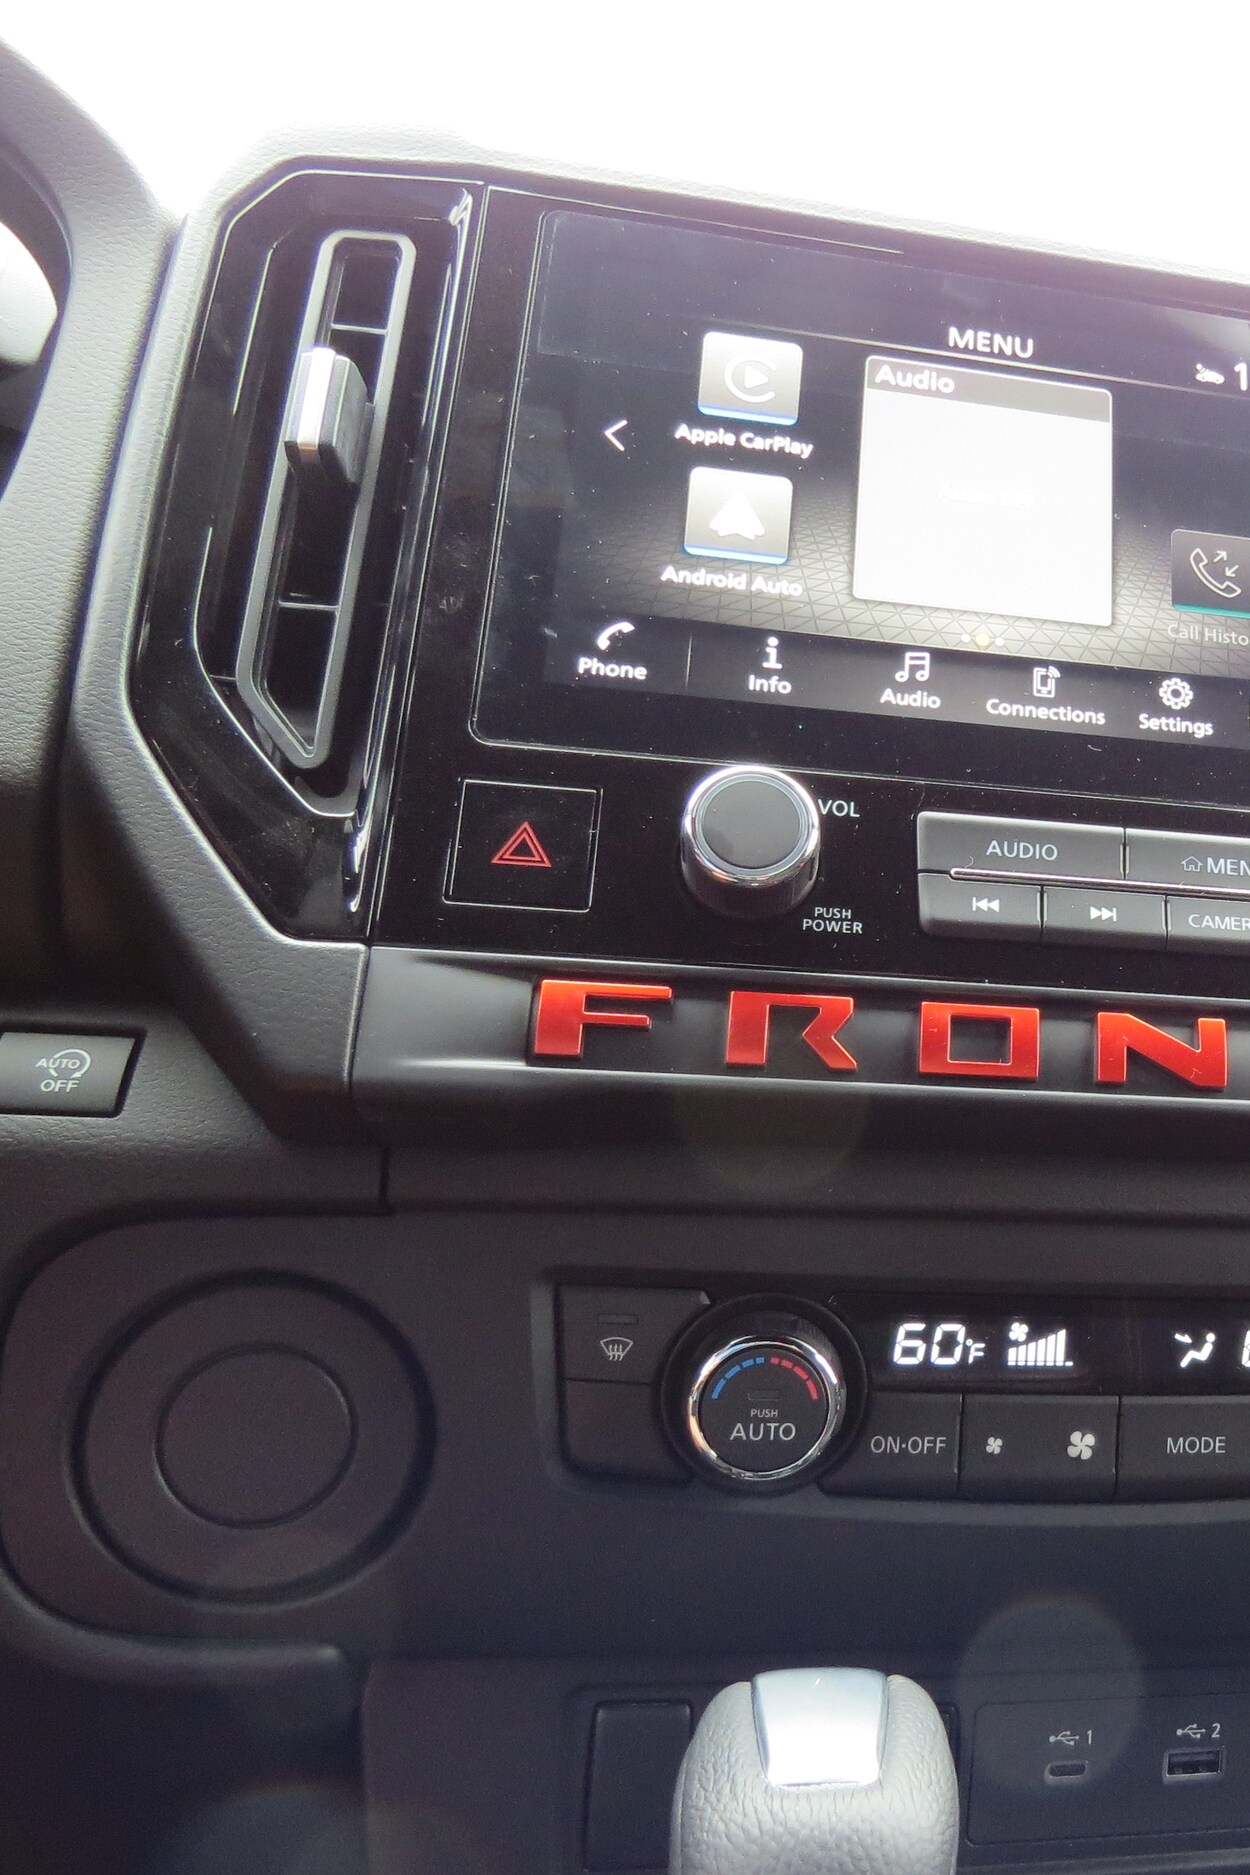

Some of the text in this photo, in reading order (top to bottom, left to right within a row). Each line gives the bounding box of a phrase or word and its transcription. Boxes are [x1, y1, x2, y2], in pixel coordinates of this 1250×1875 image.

[948, 326, 1034, 359] MENU
[874, 364, 955, 394] Audio
[674, 422, 814, 459] Apple CarPlay
[660, 565, 803, 597] Android Auto
[1167, 624, 1199, 641] Call
[578, 656, 648, 680] Phone
[748, 674, 792, 695] Info
[880, 688, 941, 709] Audio
[986, 698, 1106, 726] Connections
[1138, 713, 1214, 738] Settings
[817, 799, 861, 818] VOL
[986, 840, 1058, 861] AUDIO
[814, 906, 852, 920] PUSH
[802, 919, 863, 934] POWER
[35, 1058, 81, 1070] AUTO
[40, 1079, 80, 1093] OFF
[750, 1408, 779, 1418] PUSH
[730, 1422, 796, 1442] AUTO
[1166, 1436, 1226, 1454] MODE
[1085, 1729, 1094, 1745] 1
[1211, 1723, 1221, 1739] 2
